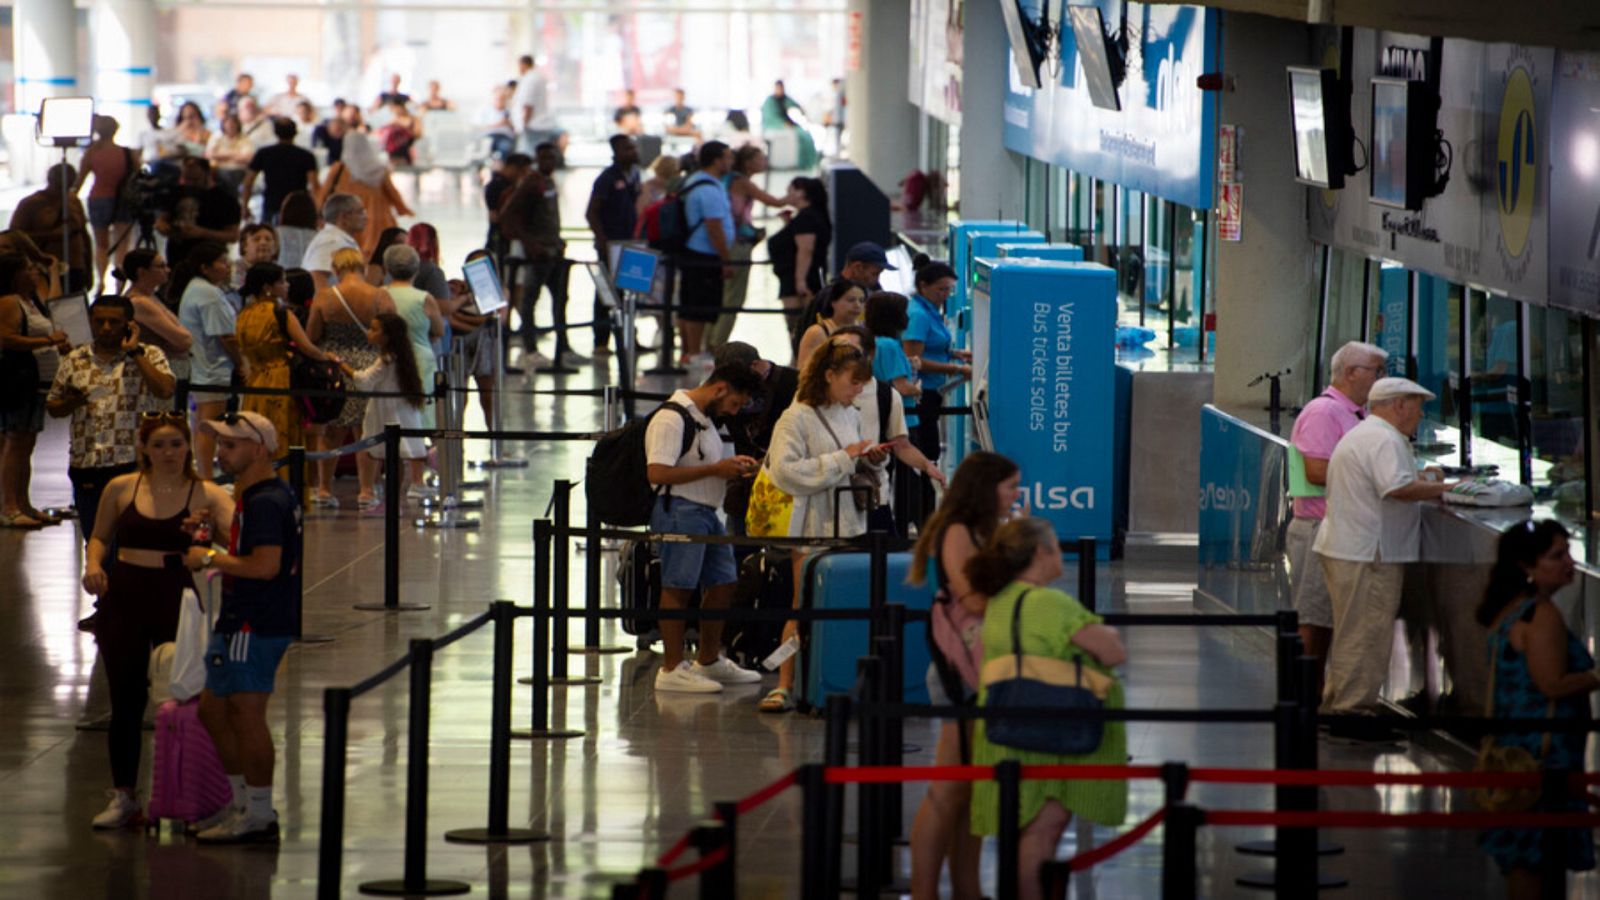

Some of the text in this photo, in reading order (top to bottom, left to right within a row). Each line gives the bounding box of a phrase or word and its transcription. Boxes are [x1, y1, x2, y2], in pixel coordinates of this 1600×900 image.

[1030, 302, 1051, 431] Bus ticket sales
[1053, 302, 1075, 453] Venta billetes bus
